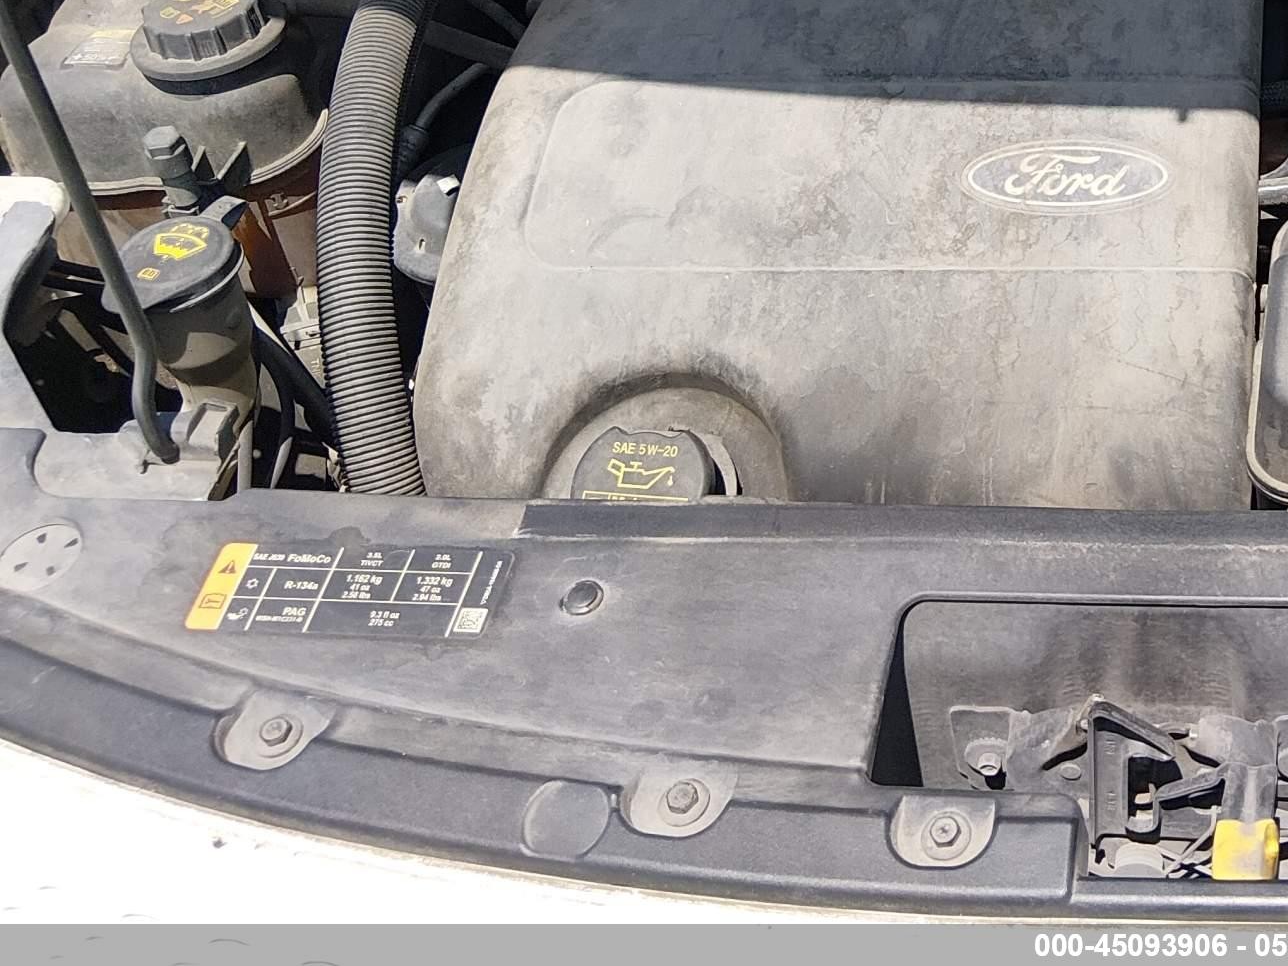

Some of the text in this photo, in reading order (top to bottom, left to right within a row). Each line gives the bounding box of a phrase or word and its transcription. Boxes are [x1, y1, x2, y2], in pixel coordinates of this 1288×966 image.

[1003, 152, 1130, 197] Ford
[612, 442, 679, 458] SAE 5W-20
[253, 553, 269, 561] SAE
[287, 554, 332, 564] FoMoCo
[370, 574, 383, 585] kg
[440, 576, 454, 587] kg
[284, 580, 319, 590] R-134a
[350, 583, 361, 591] 41
[420, 585, 432, 593] 47
[282, 606, 306, 616] PAG
[370, 610, 383, 618] 9.3
[368, 618, 384, 626] 275
